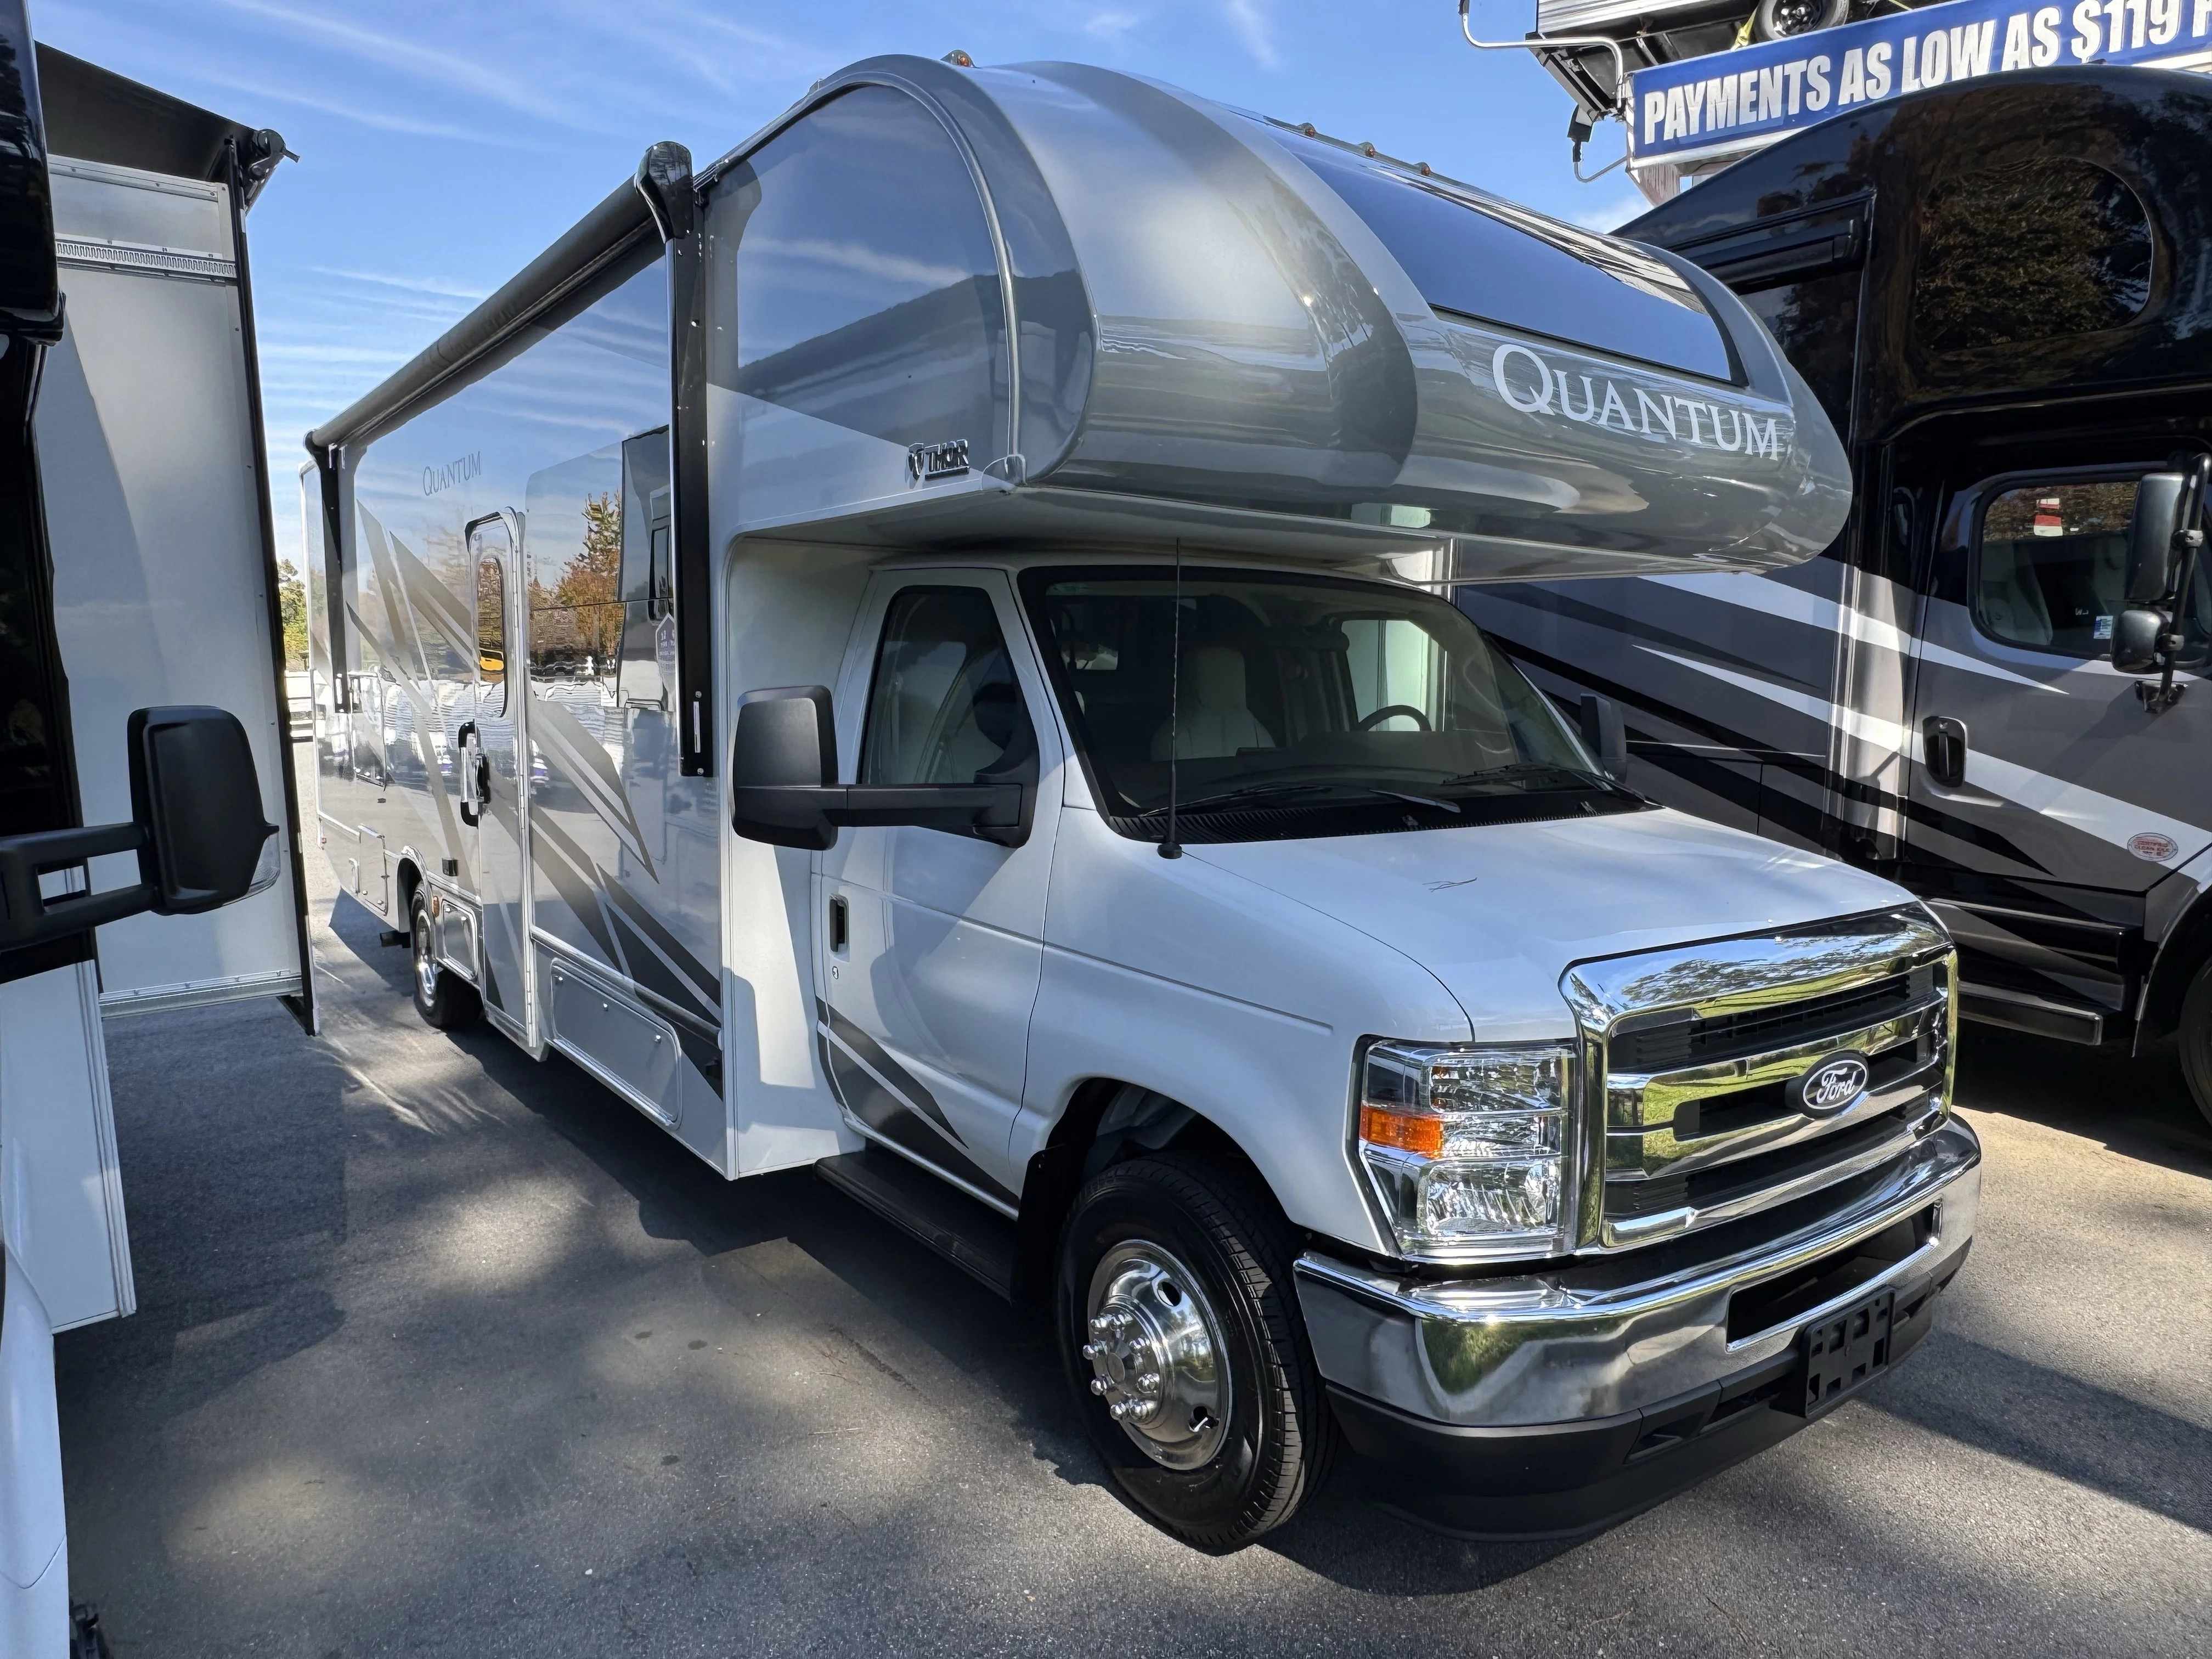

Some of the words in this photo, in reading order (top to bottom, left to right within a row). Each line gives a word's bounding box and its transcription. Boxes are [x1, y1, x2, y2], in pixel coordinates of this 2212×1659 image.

[1645, 55, 1831, 144] PAYMENTS
[1838, 42, 1892, 105] AS
[1900, 19, 1997, 93] LOW
[2001, 6, 2061, 71] AS
[2071, 0, 2181, 64] $119
[1493, 344, 1778, 461] QUANTUM
[423, 451, 481, 496] QUANTUM
[924, 439, 969, 473] THOR
[1816, 1067, 1857, 1103] Ford
